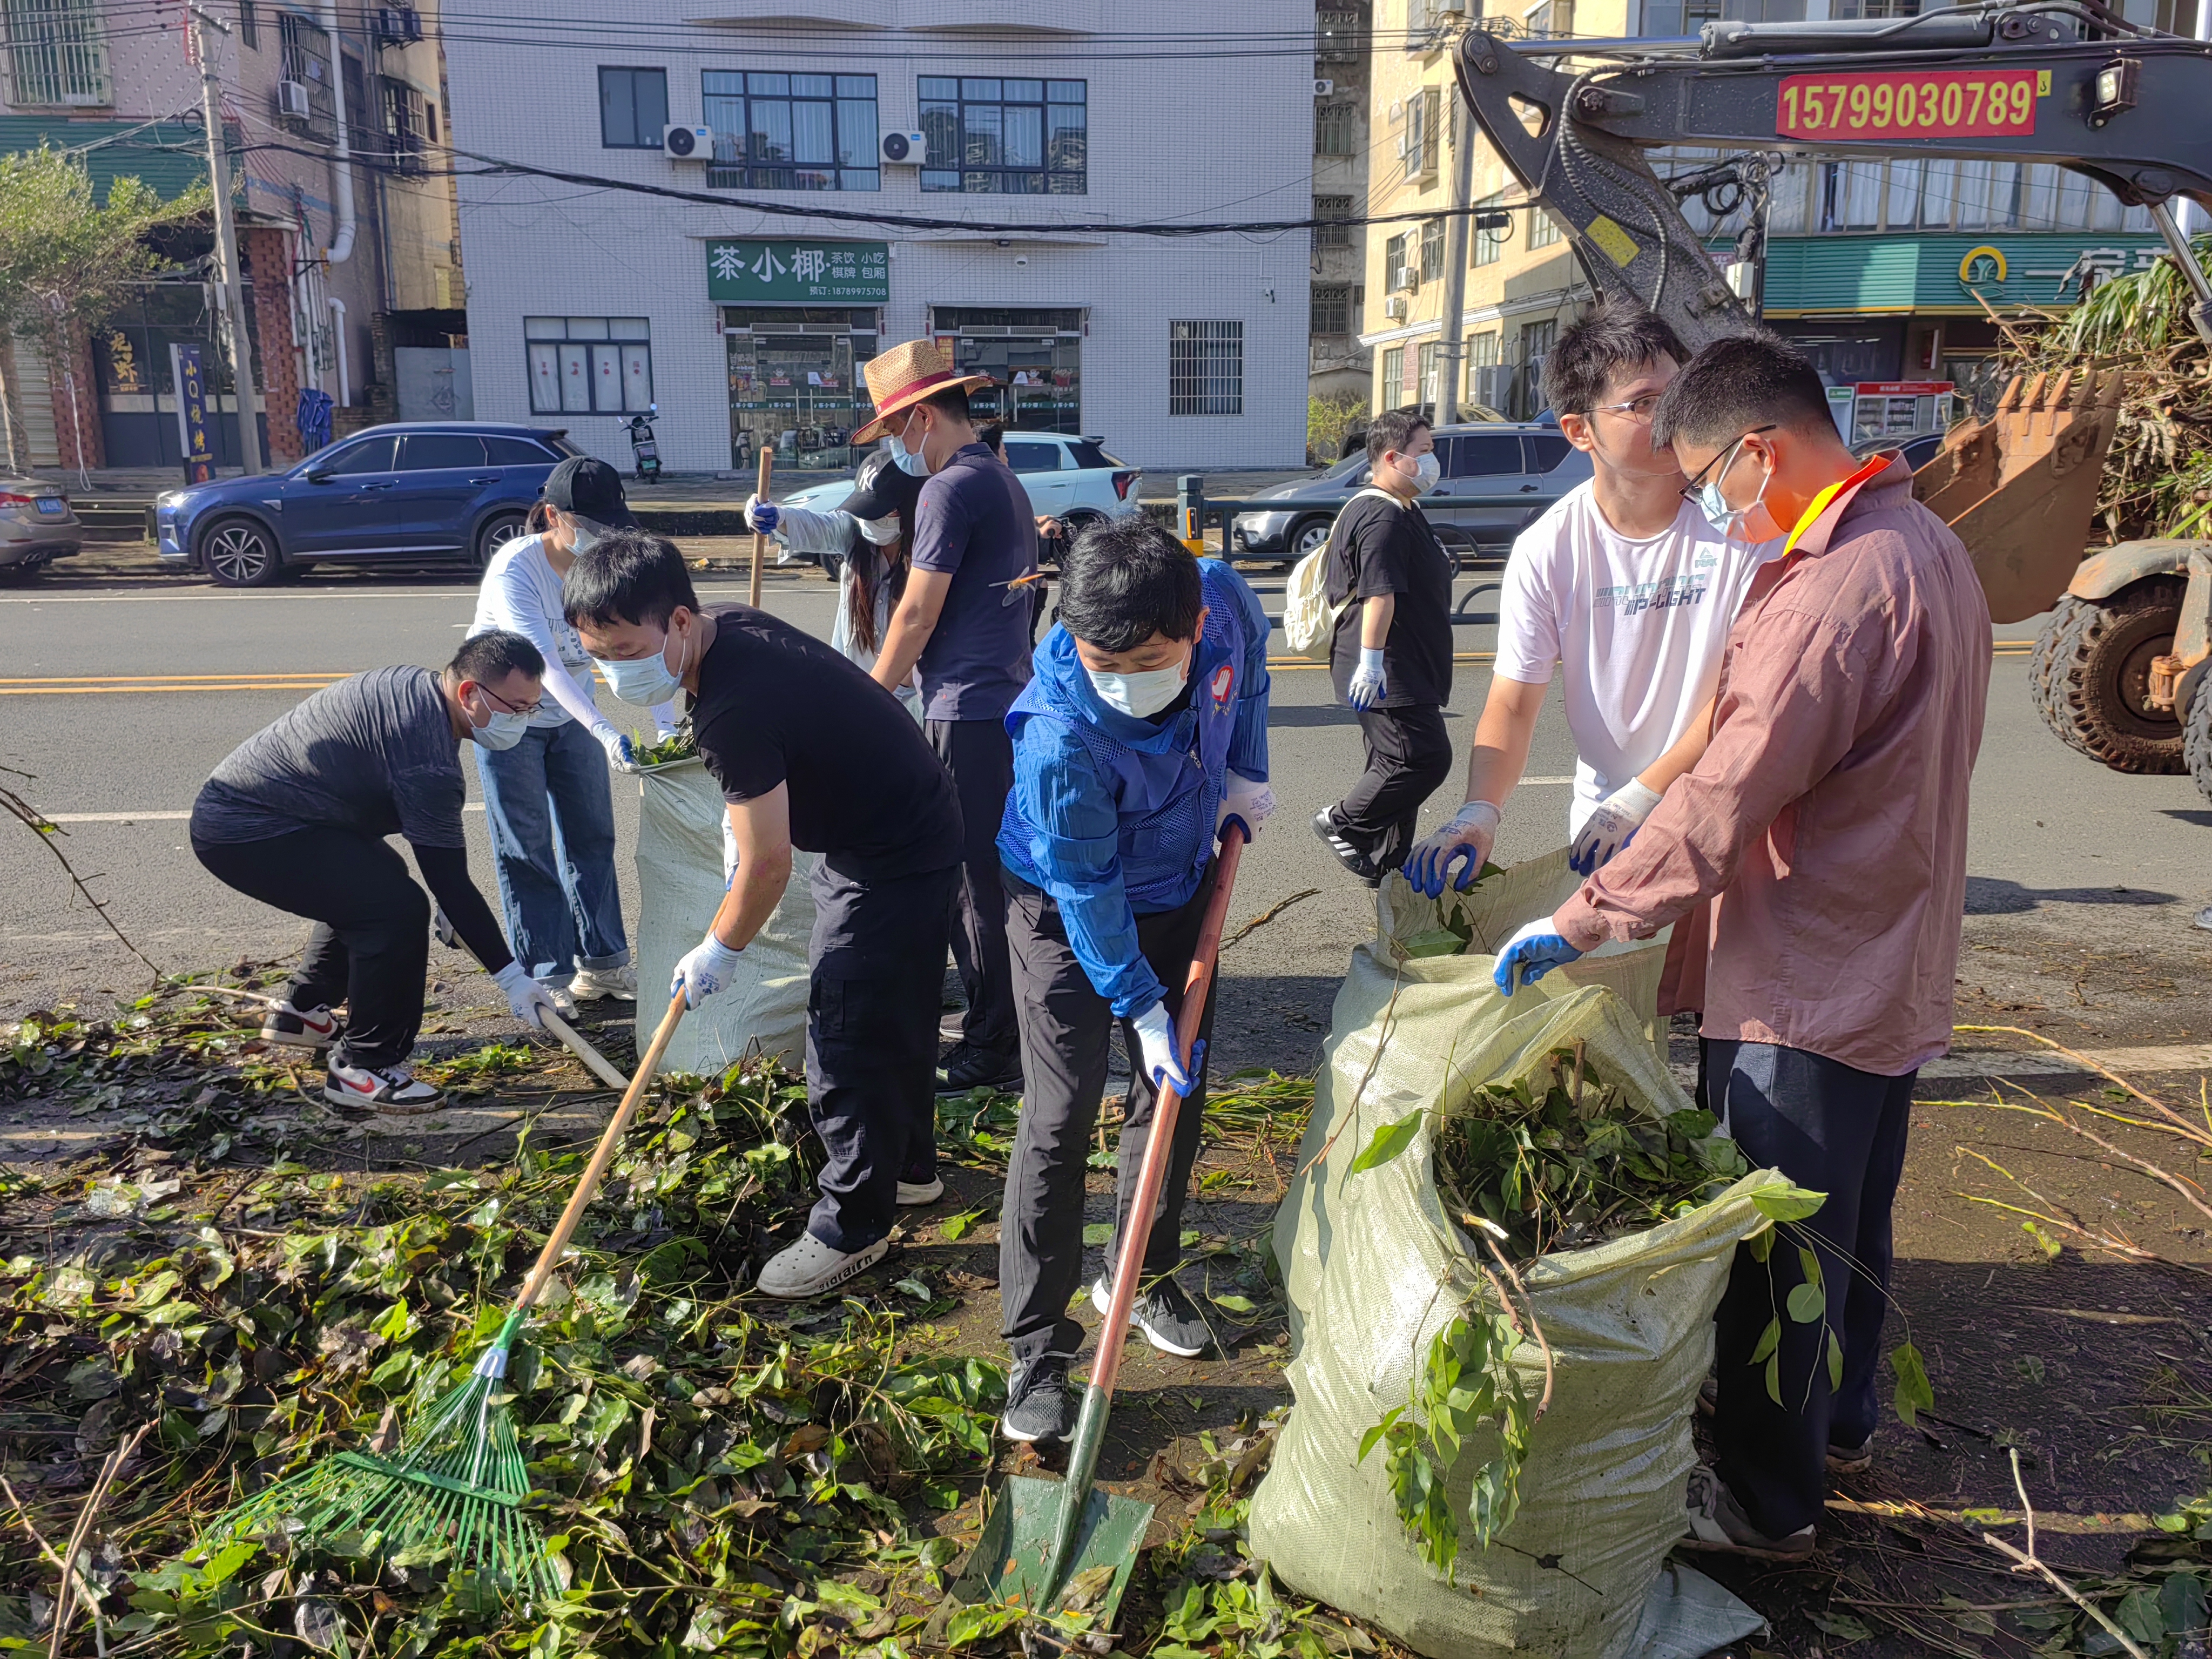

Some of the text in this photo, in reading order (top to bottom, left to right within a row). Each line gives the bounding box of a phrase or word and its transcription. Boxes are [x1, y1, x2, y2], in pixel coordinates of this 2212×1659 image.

[1783, 80, 2031, 130] 15799030789
[710, 245, 826, 282] 茶小椰
[831, 252, 886, 264] 茶饮 小吃
[832, 266, 886, 279] 棋牌 包厢
